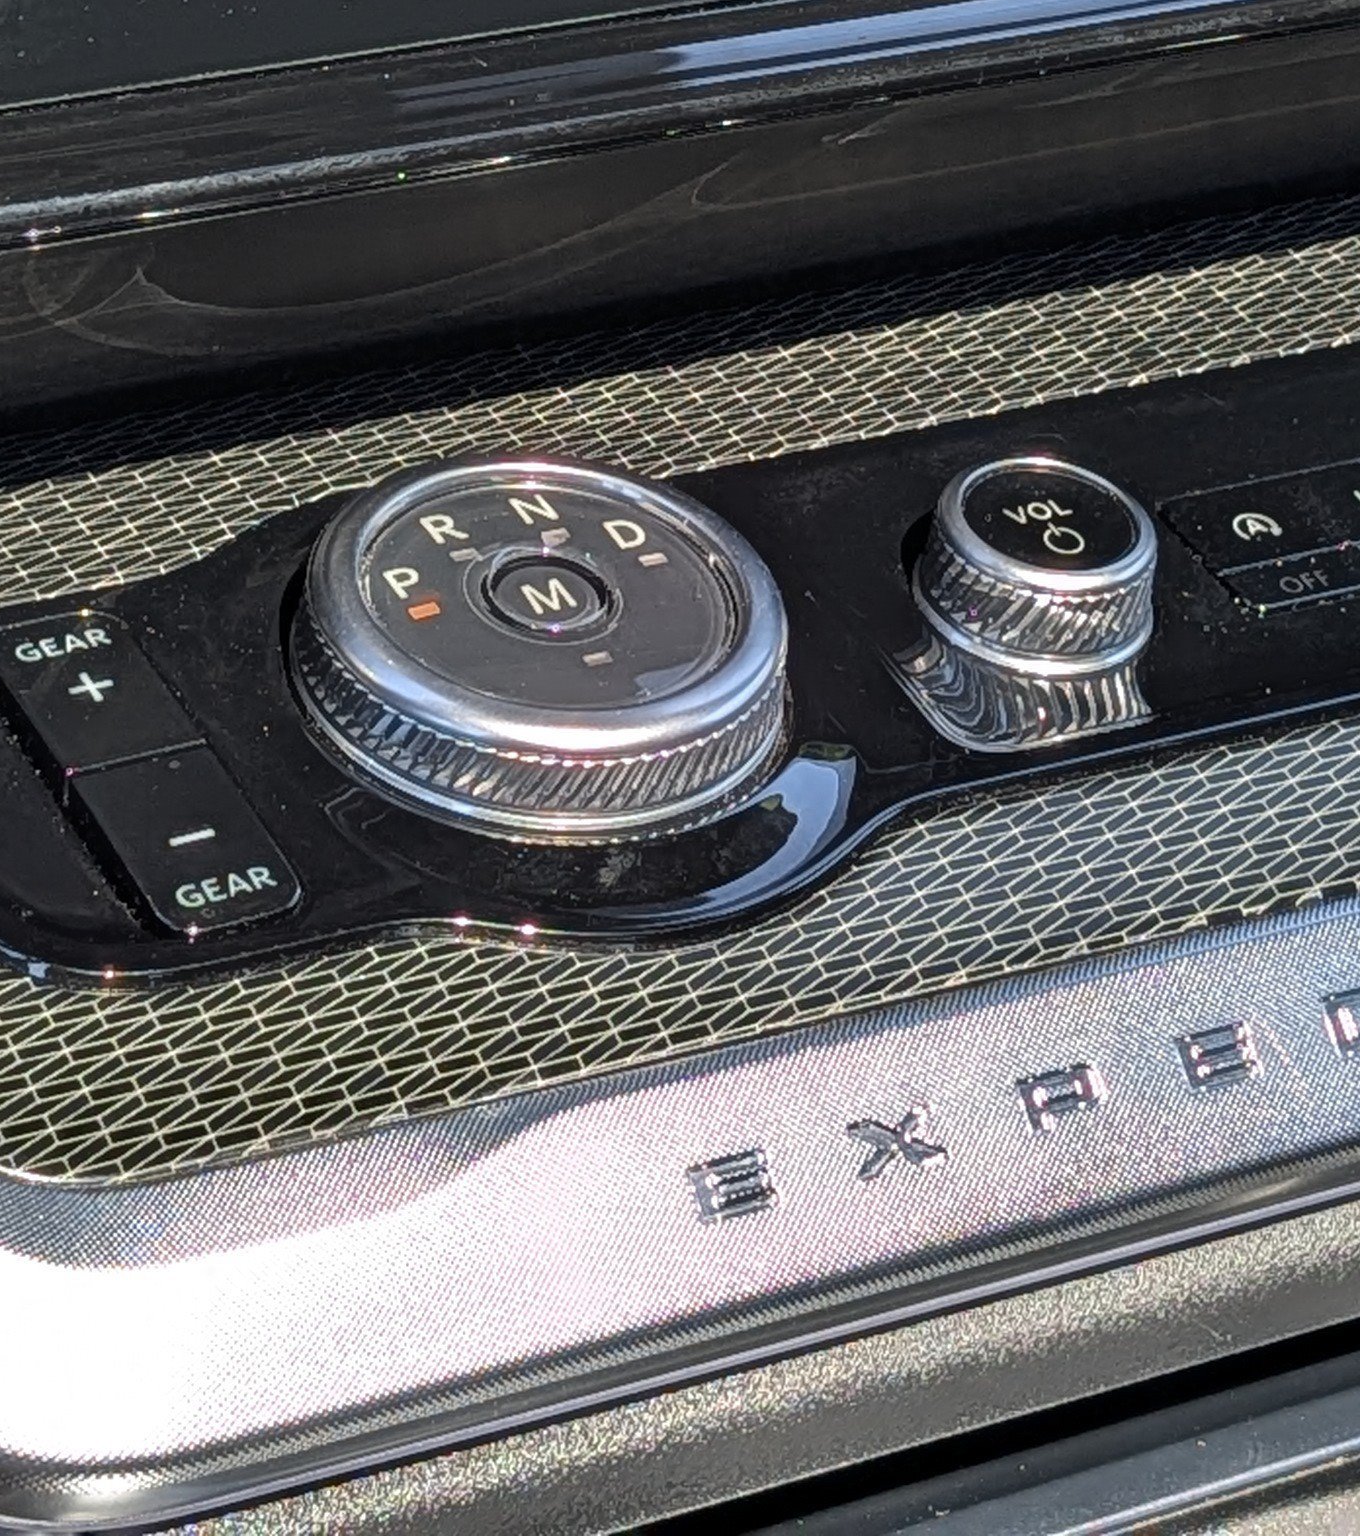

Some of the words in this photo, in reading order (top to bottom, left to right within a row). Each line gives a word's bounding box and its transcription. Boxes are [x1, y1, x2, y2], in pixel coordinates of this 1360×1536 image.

[508, 493, 560, 526] N
[1001, 498, 1074, 525] VOL
[419, 514, 470, 545] R
[602, 519, 646, 550] D
[382, 566, 420, 600] P
[519, 577, 578, 615] M
[1278, 568, 1330, 594] OFF
[14, 627, 113, 664] GEAR
[174, 865, 278, 910] GEAR
